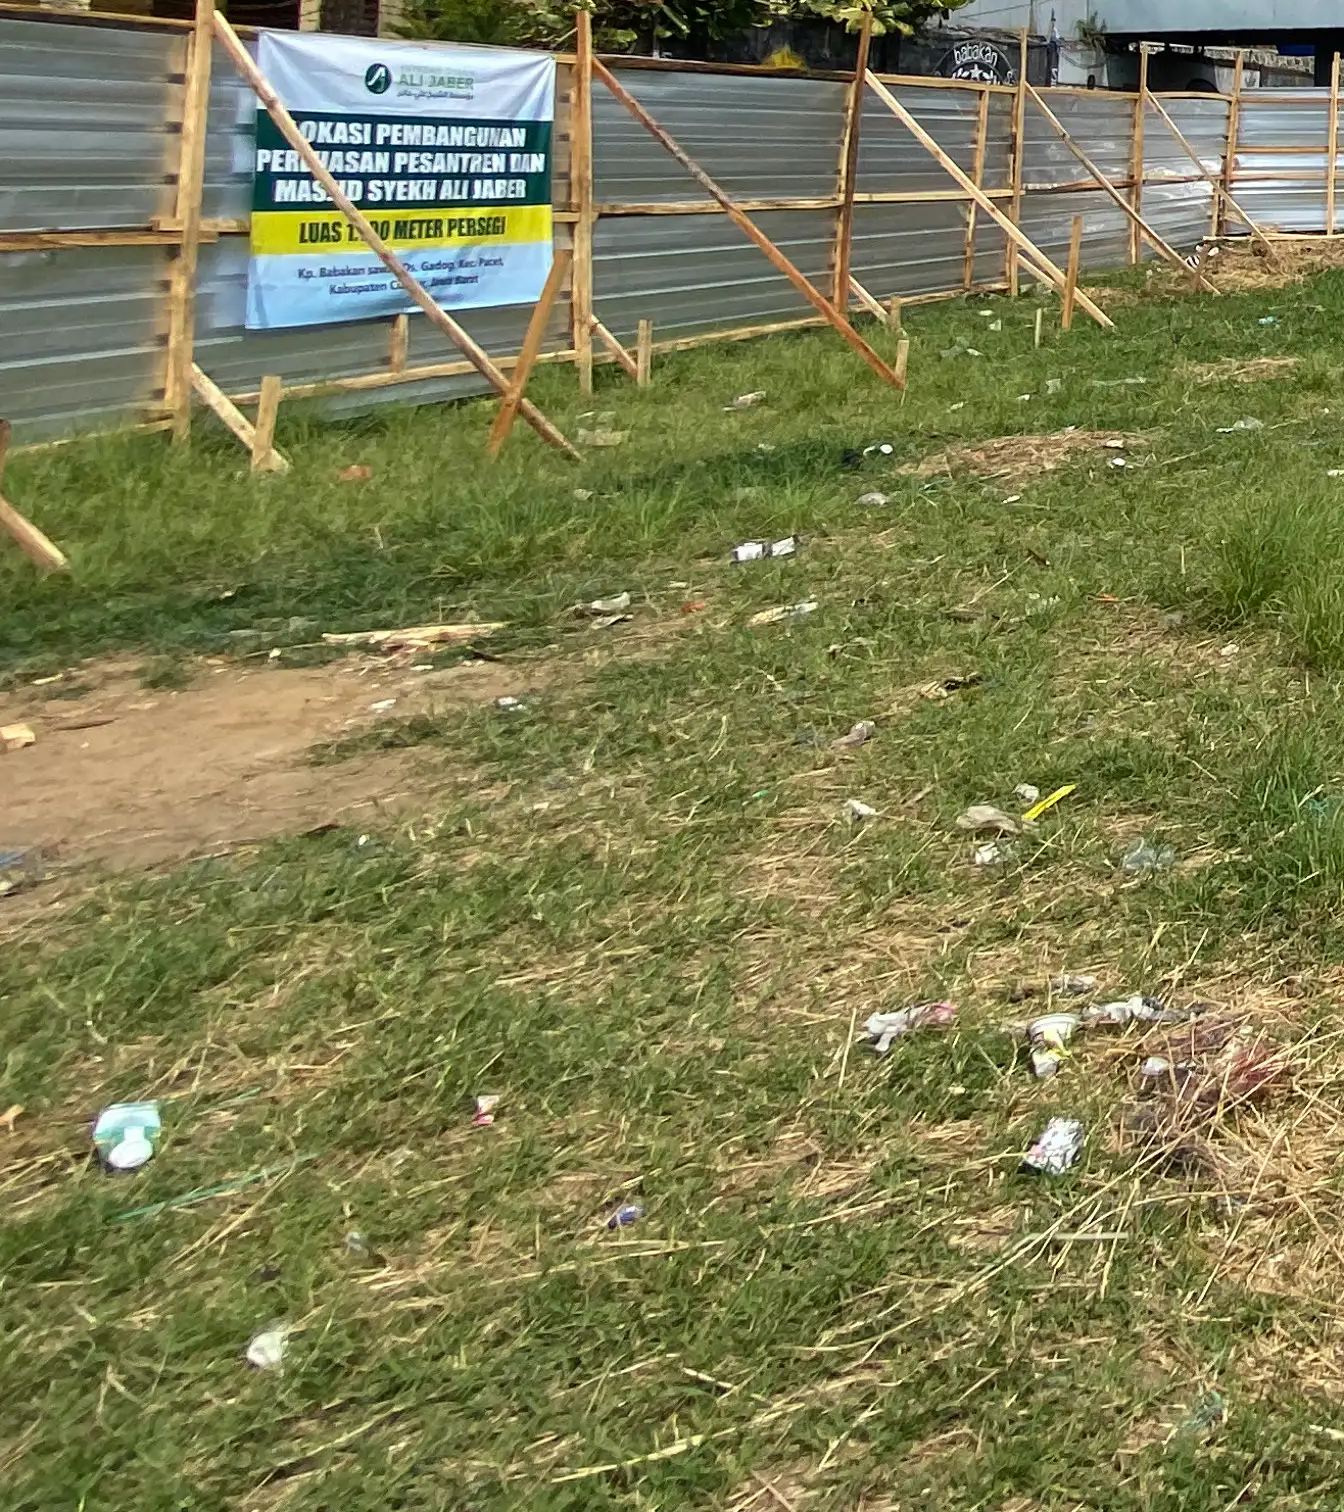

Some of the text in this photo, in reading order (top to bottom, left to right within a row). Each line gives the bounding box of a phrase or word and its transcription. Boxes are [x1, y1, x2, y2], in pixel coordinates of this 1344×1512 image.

[398, 73, 424, 87] ALI
[297, 120, 527, 148] OKASI PEMBANGUNAN
[393, 152, 507, 174] PESANTREN
[509, 152, 546, 174] DAN
[367, 179, 438, 202] SYEKH
[439, 179, 470, 200] ALI
[472, 179, 527, 200] JABER
[299, 220, 343, 244] LUAS
[393, 218, 444, 239] METER
[446, 215, 507, 238] PERSEGI
